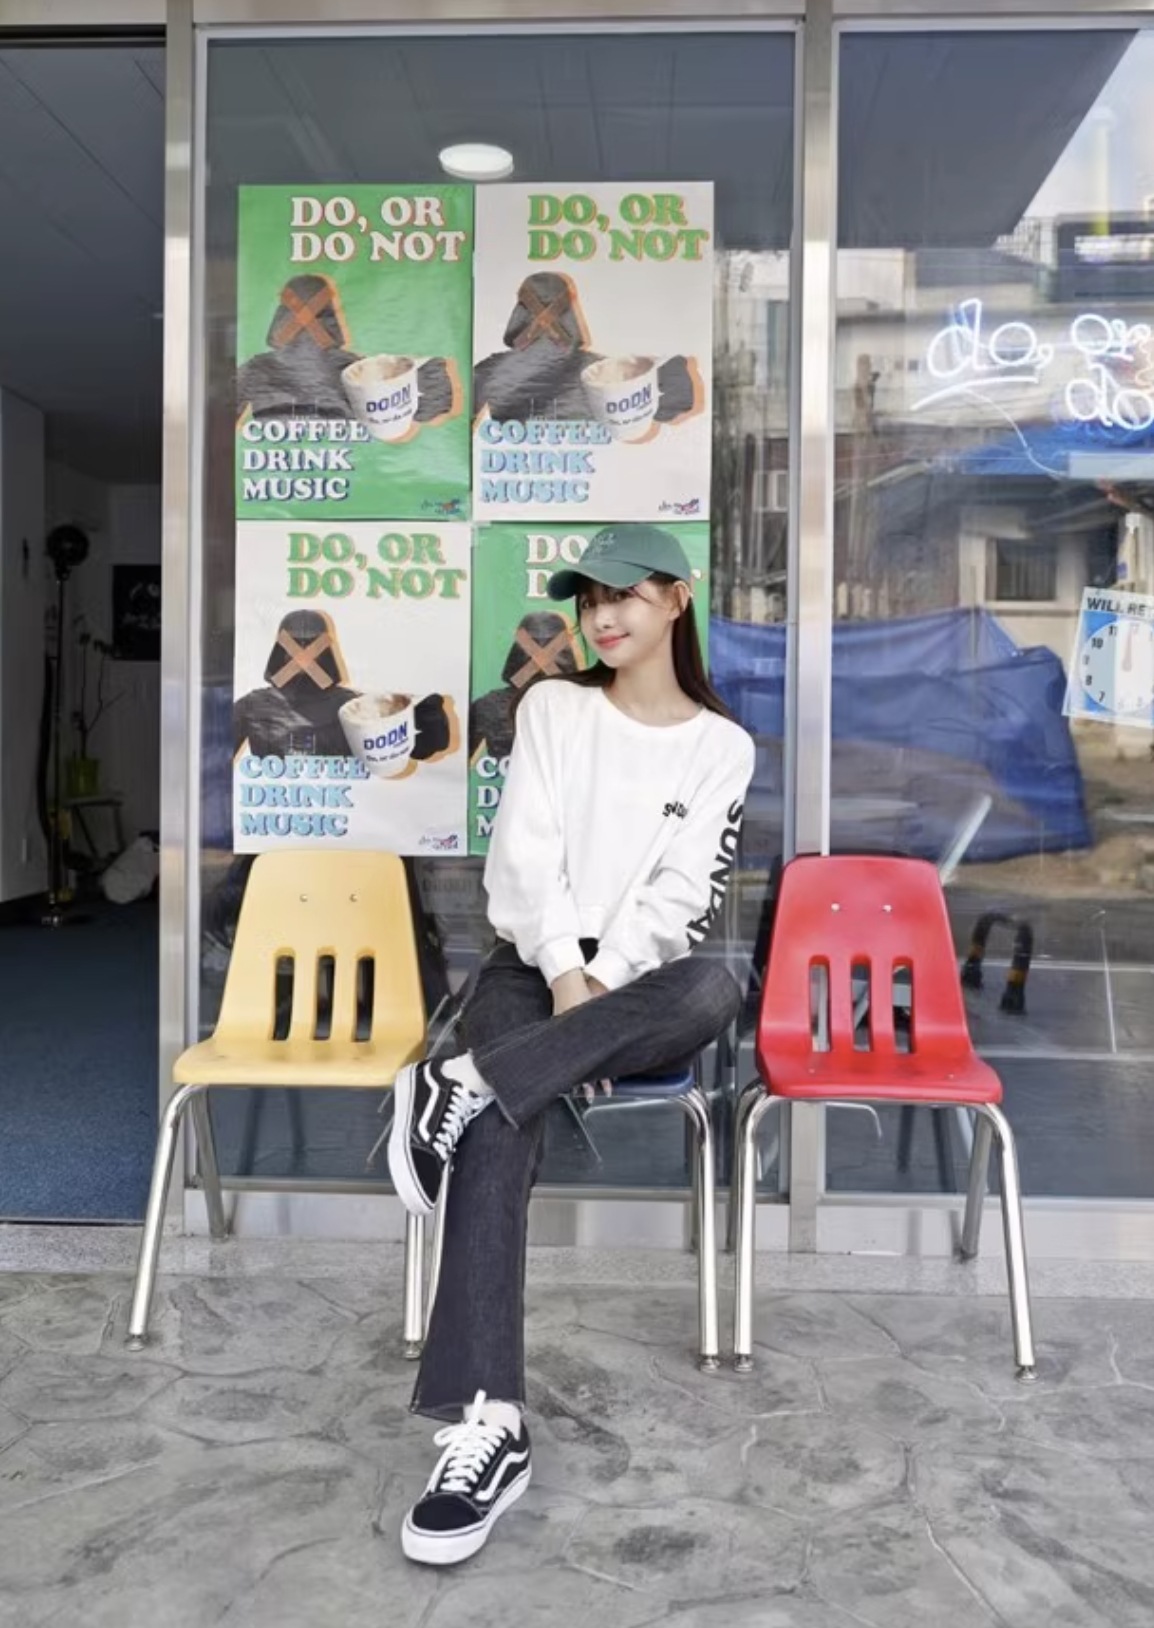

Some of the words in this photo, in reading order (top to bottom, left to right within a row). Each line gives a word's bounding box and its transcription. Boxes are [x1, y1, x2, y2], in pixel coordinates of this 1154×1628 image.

[289, 196, 368, 233] DO,
[380, 196, 446, 228] OR
[528, 194, 609, 232] DO,
[619, 194, 688, 227] OR
[289, 231, 356, 262] DO
[369, 231, 467, 262] NOT
[528, 229, 597, 262] DO
[608, 229, 709, 262] NOT
[242, 419, 370, 443] COFFEE
[479, 418, 612, 445] COFFEE
[242, 448, 354, 472] DRINK
[480, 448, 596, 475] DRINK
[242, 477, 350, 501] MUSIC
[480, 478, 590, 504] MUSIC
[286, 532, 368, 570] DO,
[377, 532, 446, 565] OR
[286, 567, 355, 599] DO
[365, 567, 468, 599] NOT
[1087, 596, 1124, 614] WILL
[1091, 637, 1105, 650] 10
[239, 754, 371, 780] COFFEE
[239, 784, 354, 808] DRINK
[239, 813, 350, 838] MUSIC
